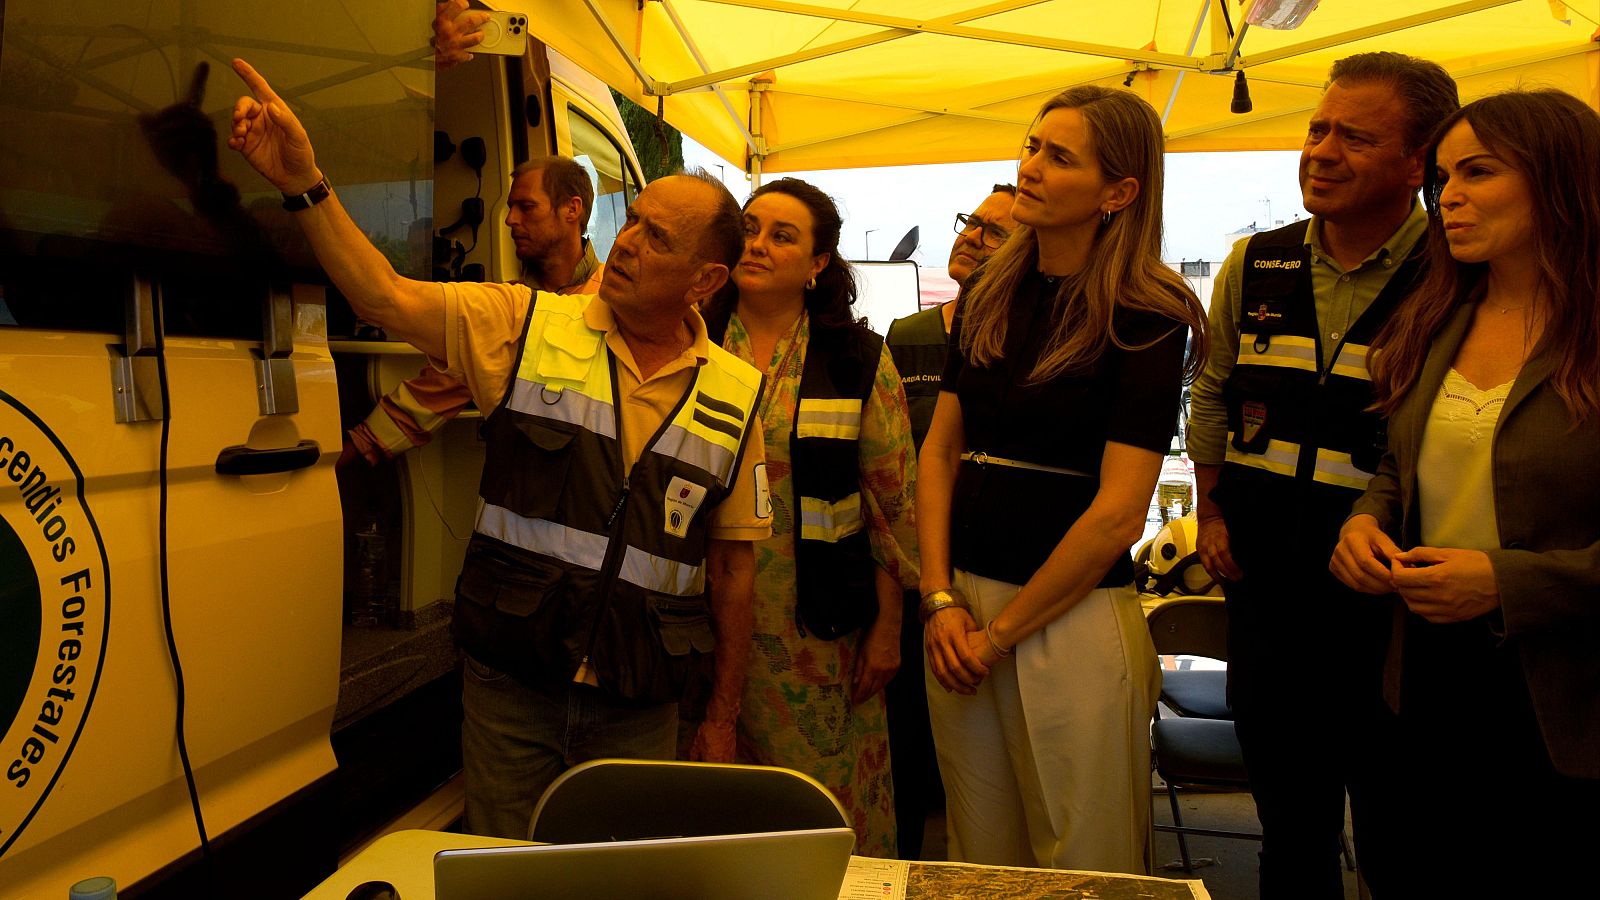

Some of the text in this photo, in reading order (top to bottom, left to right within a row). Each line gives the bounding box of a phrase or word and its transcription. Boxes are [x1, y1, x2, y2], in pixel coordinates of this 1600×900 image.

[1254, 260, 1301, 269] CONSEJERO
[922, 374, 941, 382] CIVIL
[0, 437, 92, 788] cendios Forestales
